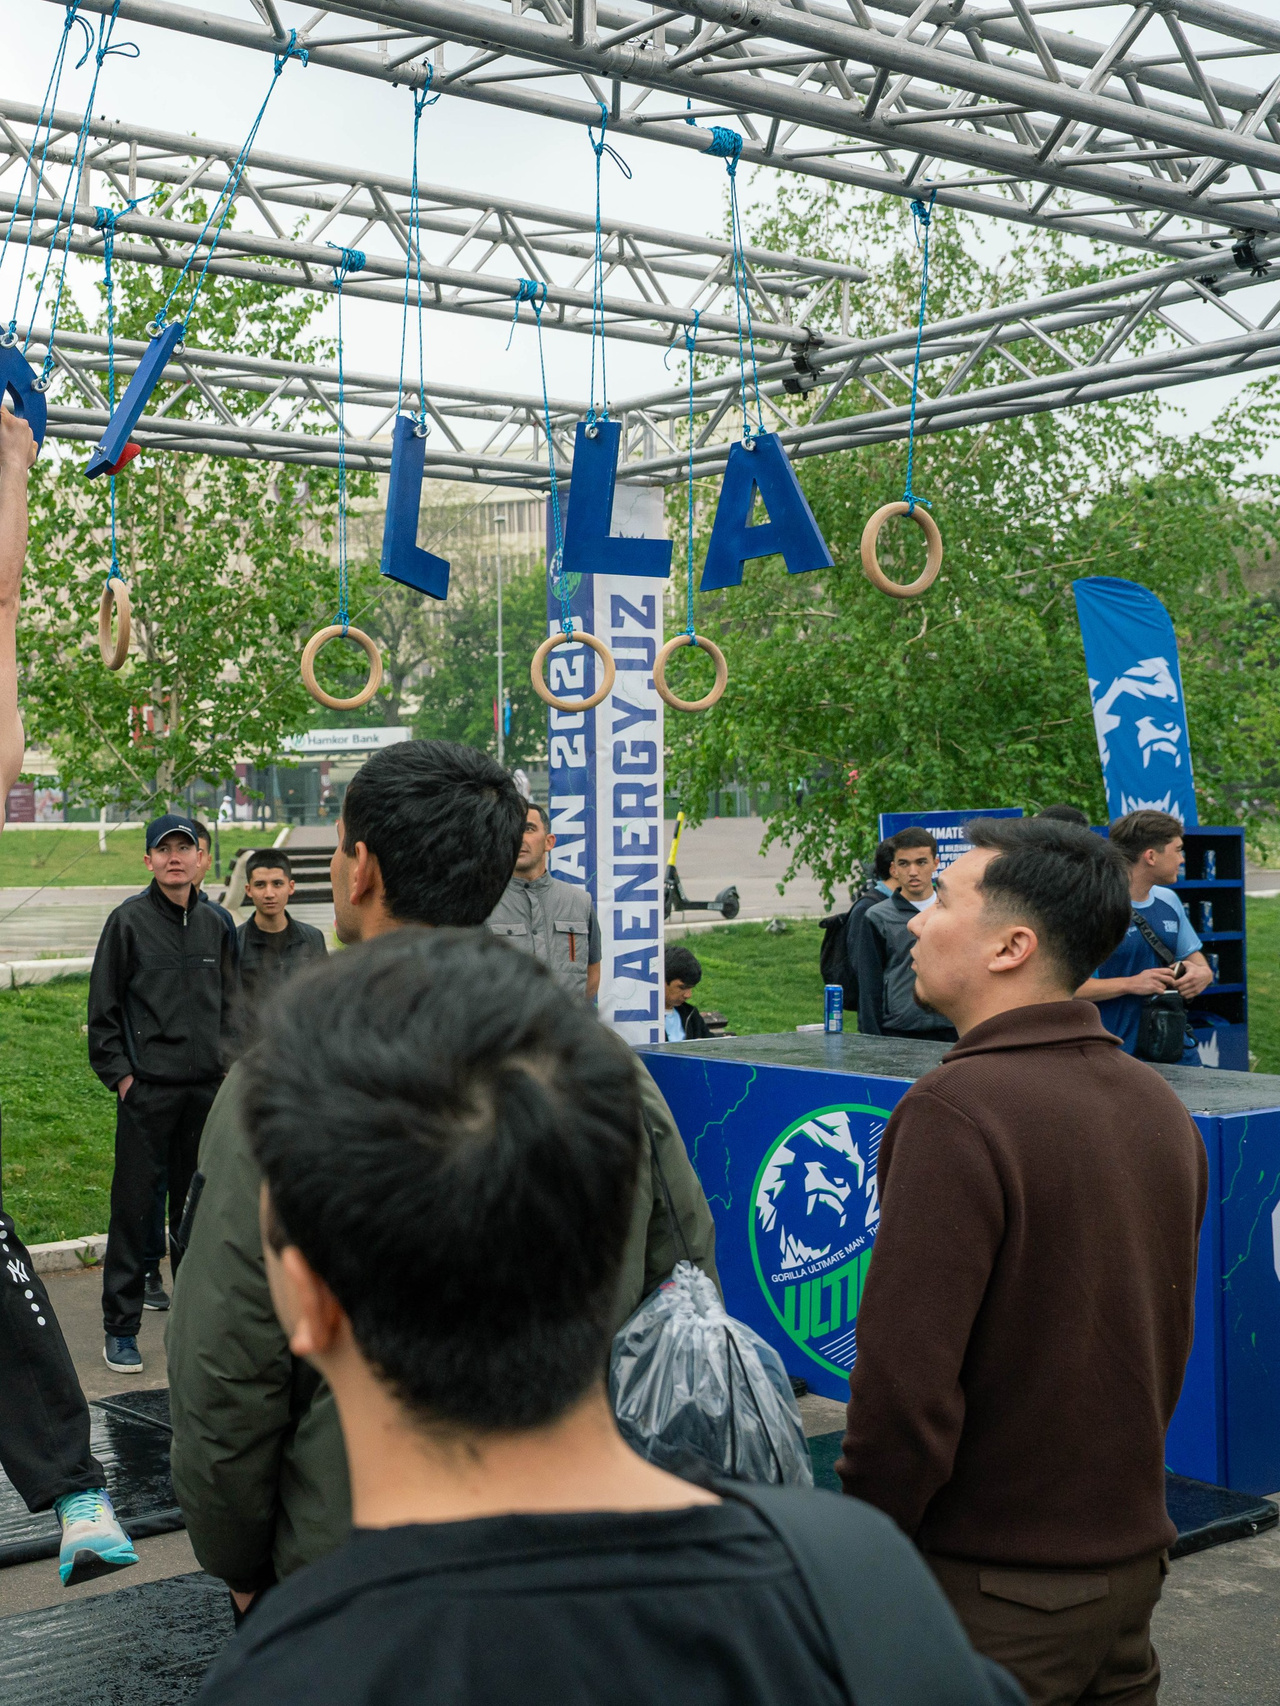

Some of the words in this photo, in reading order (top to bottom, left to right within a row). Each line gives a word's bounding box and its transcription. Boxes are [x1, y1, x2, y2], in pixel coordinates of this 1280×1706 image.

[308, 734, 349, 746] Hamkor
[352, 733, 379, 744] Bank
[771, 1266, 808, 1283] GORILLA
[806, 1249, 847, 1274] ULTIMATE
